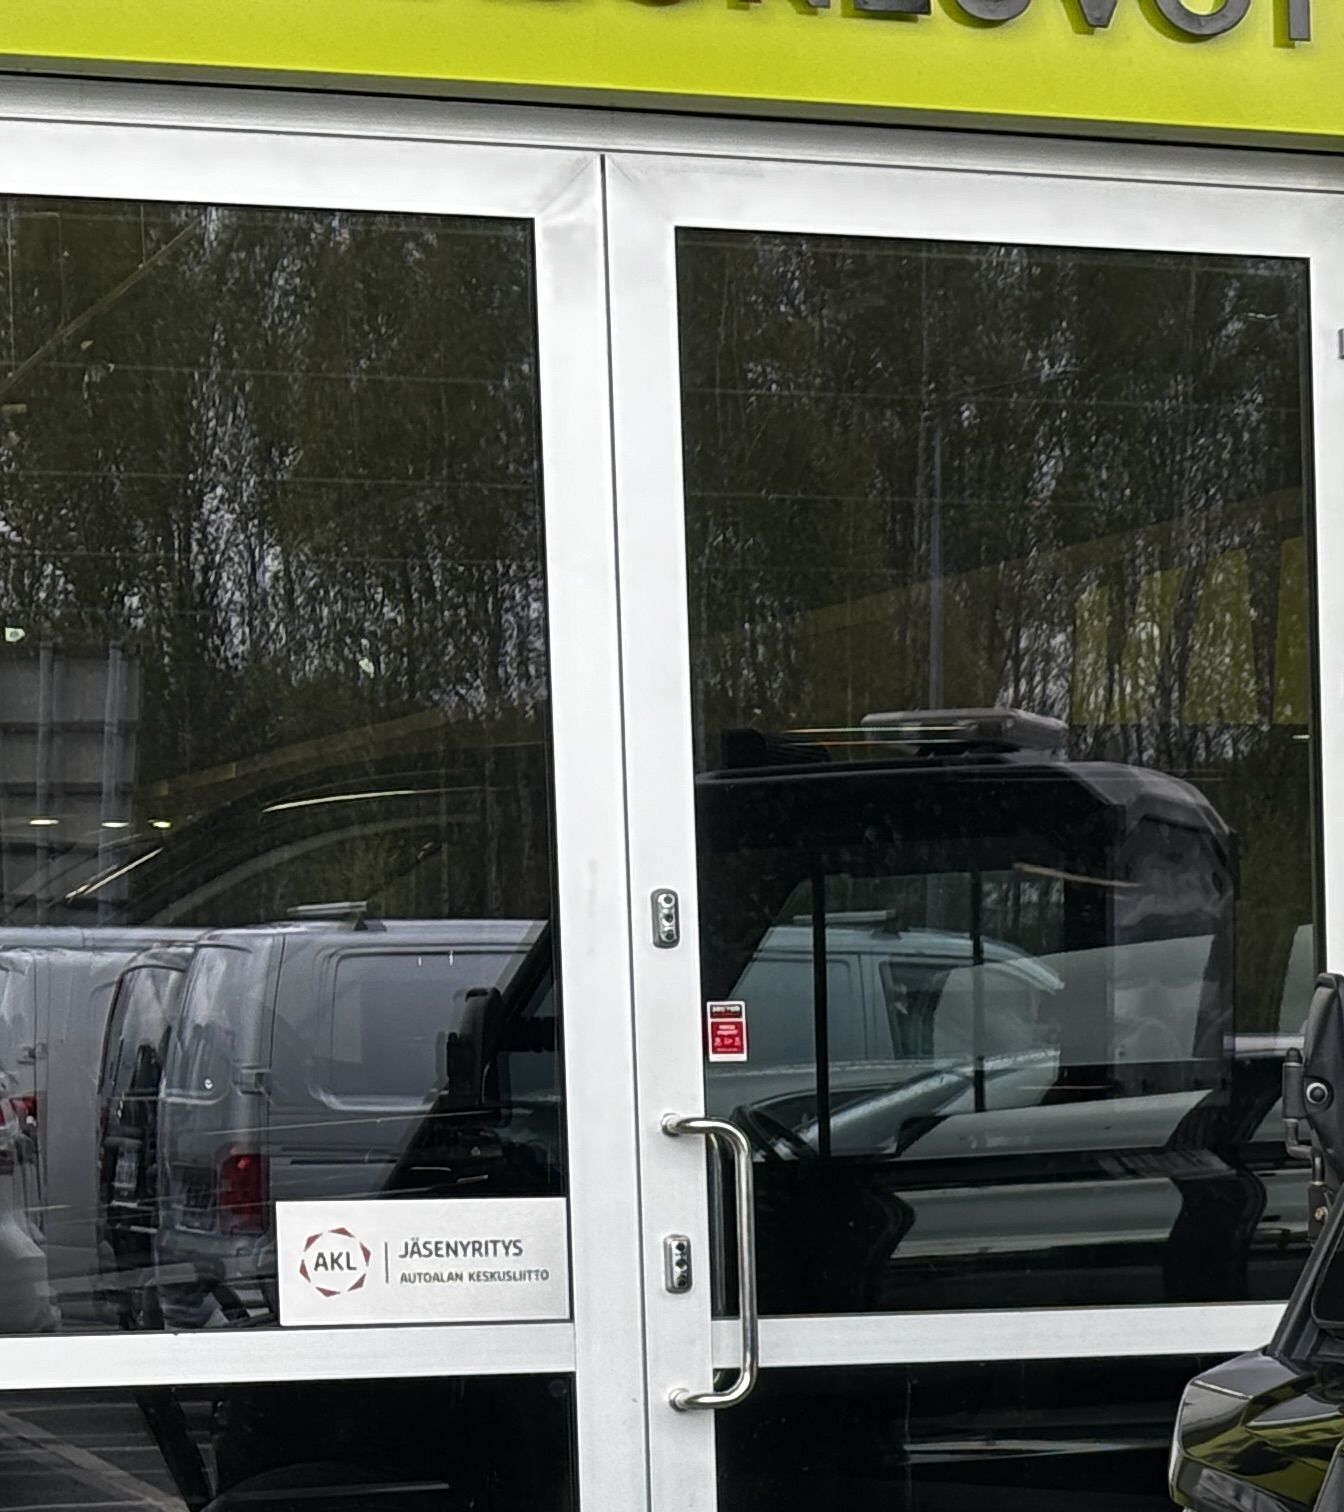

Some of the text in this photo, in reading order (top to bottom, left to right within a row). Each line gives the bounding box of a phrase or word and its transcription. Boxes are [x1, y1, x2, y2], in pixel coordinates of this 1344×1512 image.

[399, 1236, 524, 1259] JÄSENYRITYS
[313, 1251, 358, 1272] AKL
[400, 1269, 550, 1284] AUTOALAN KESKUSLIITTO
